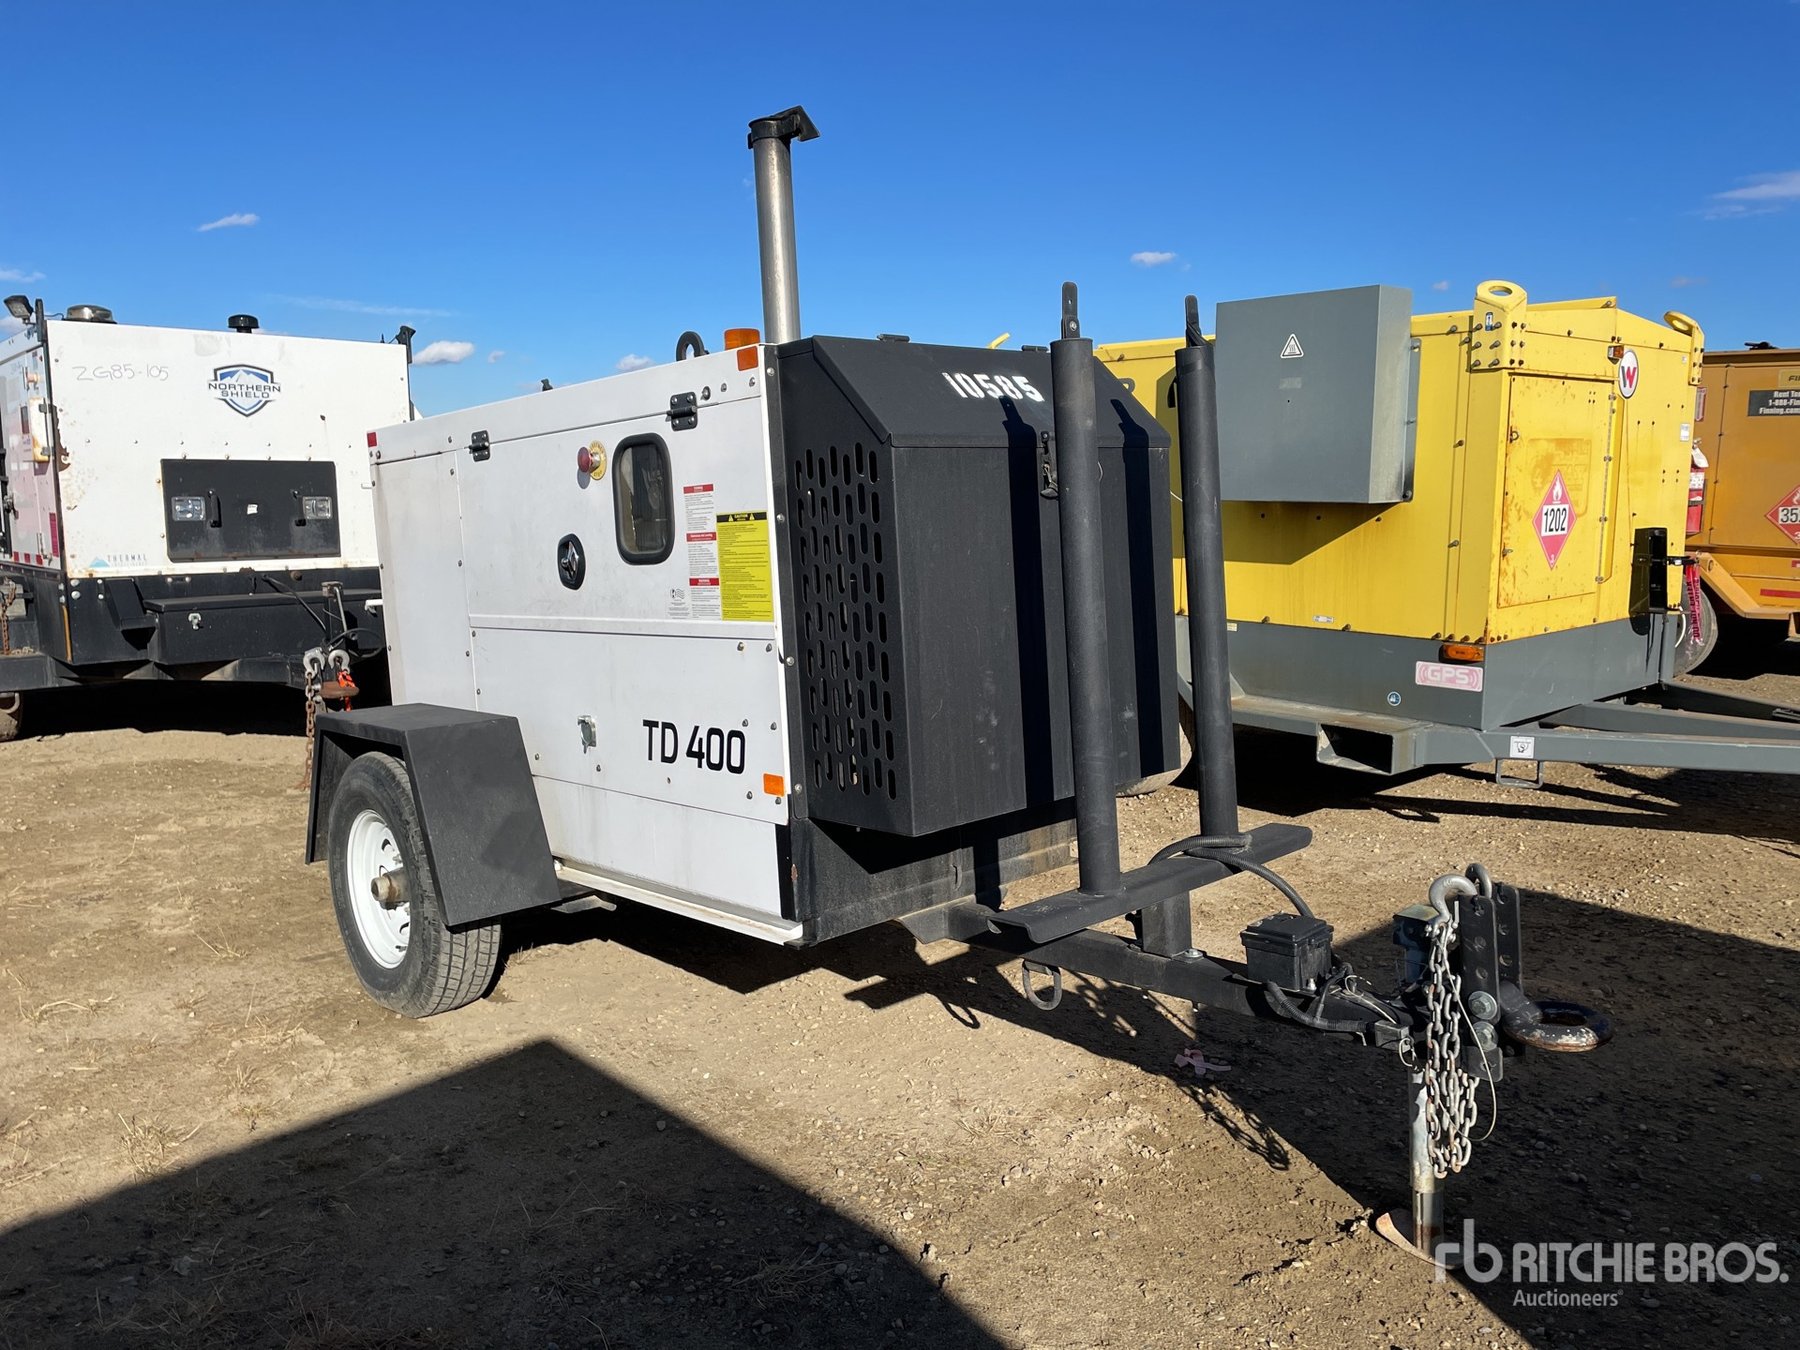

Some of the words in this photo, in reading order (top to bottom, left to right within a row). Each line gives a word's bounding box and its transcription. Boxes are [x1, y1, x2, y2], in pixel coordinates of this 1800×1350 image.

[208, 382, 281, 393] NORTHERN
[221, 390, 270, 399] SHIELD
[941, 372, 1045, 402] 10585
[1543, 507, 1568, 533] 1202
[1780, 507, 1800, 523] 35
[1428, 665, 1470, 685] GPS
[642, 719, 679, 764] TD
[685, 725, 746, 775] 400
